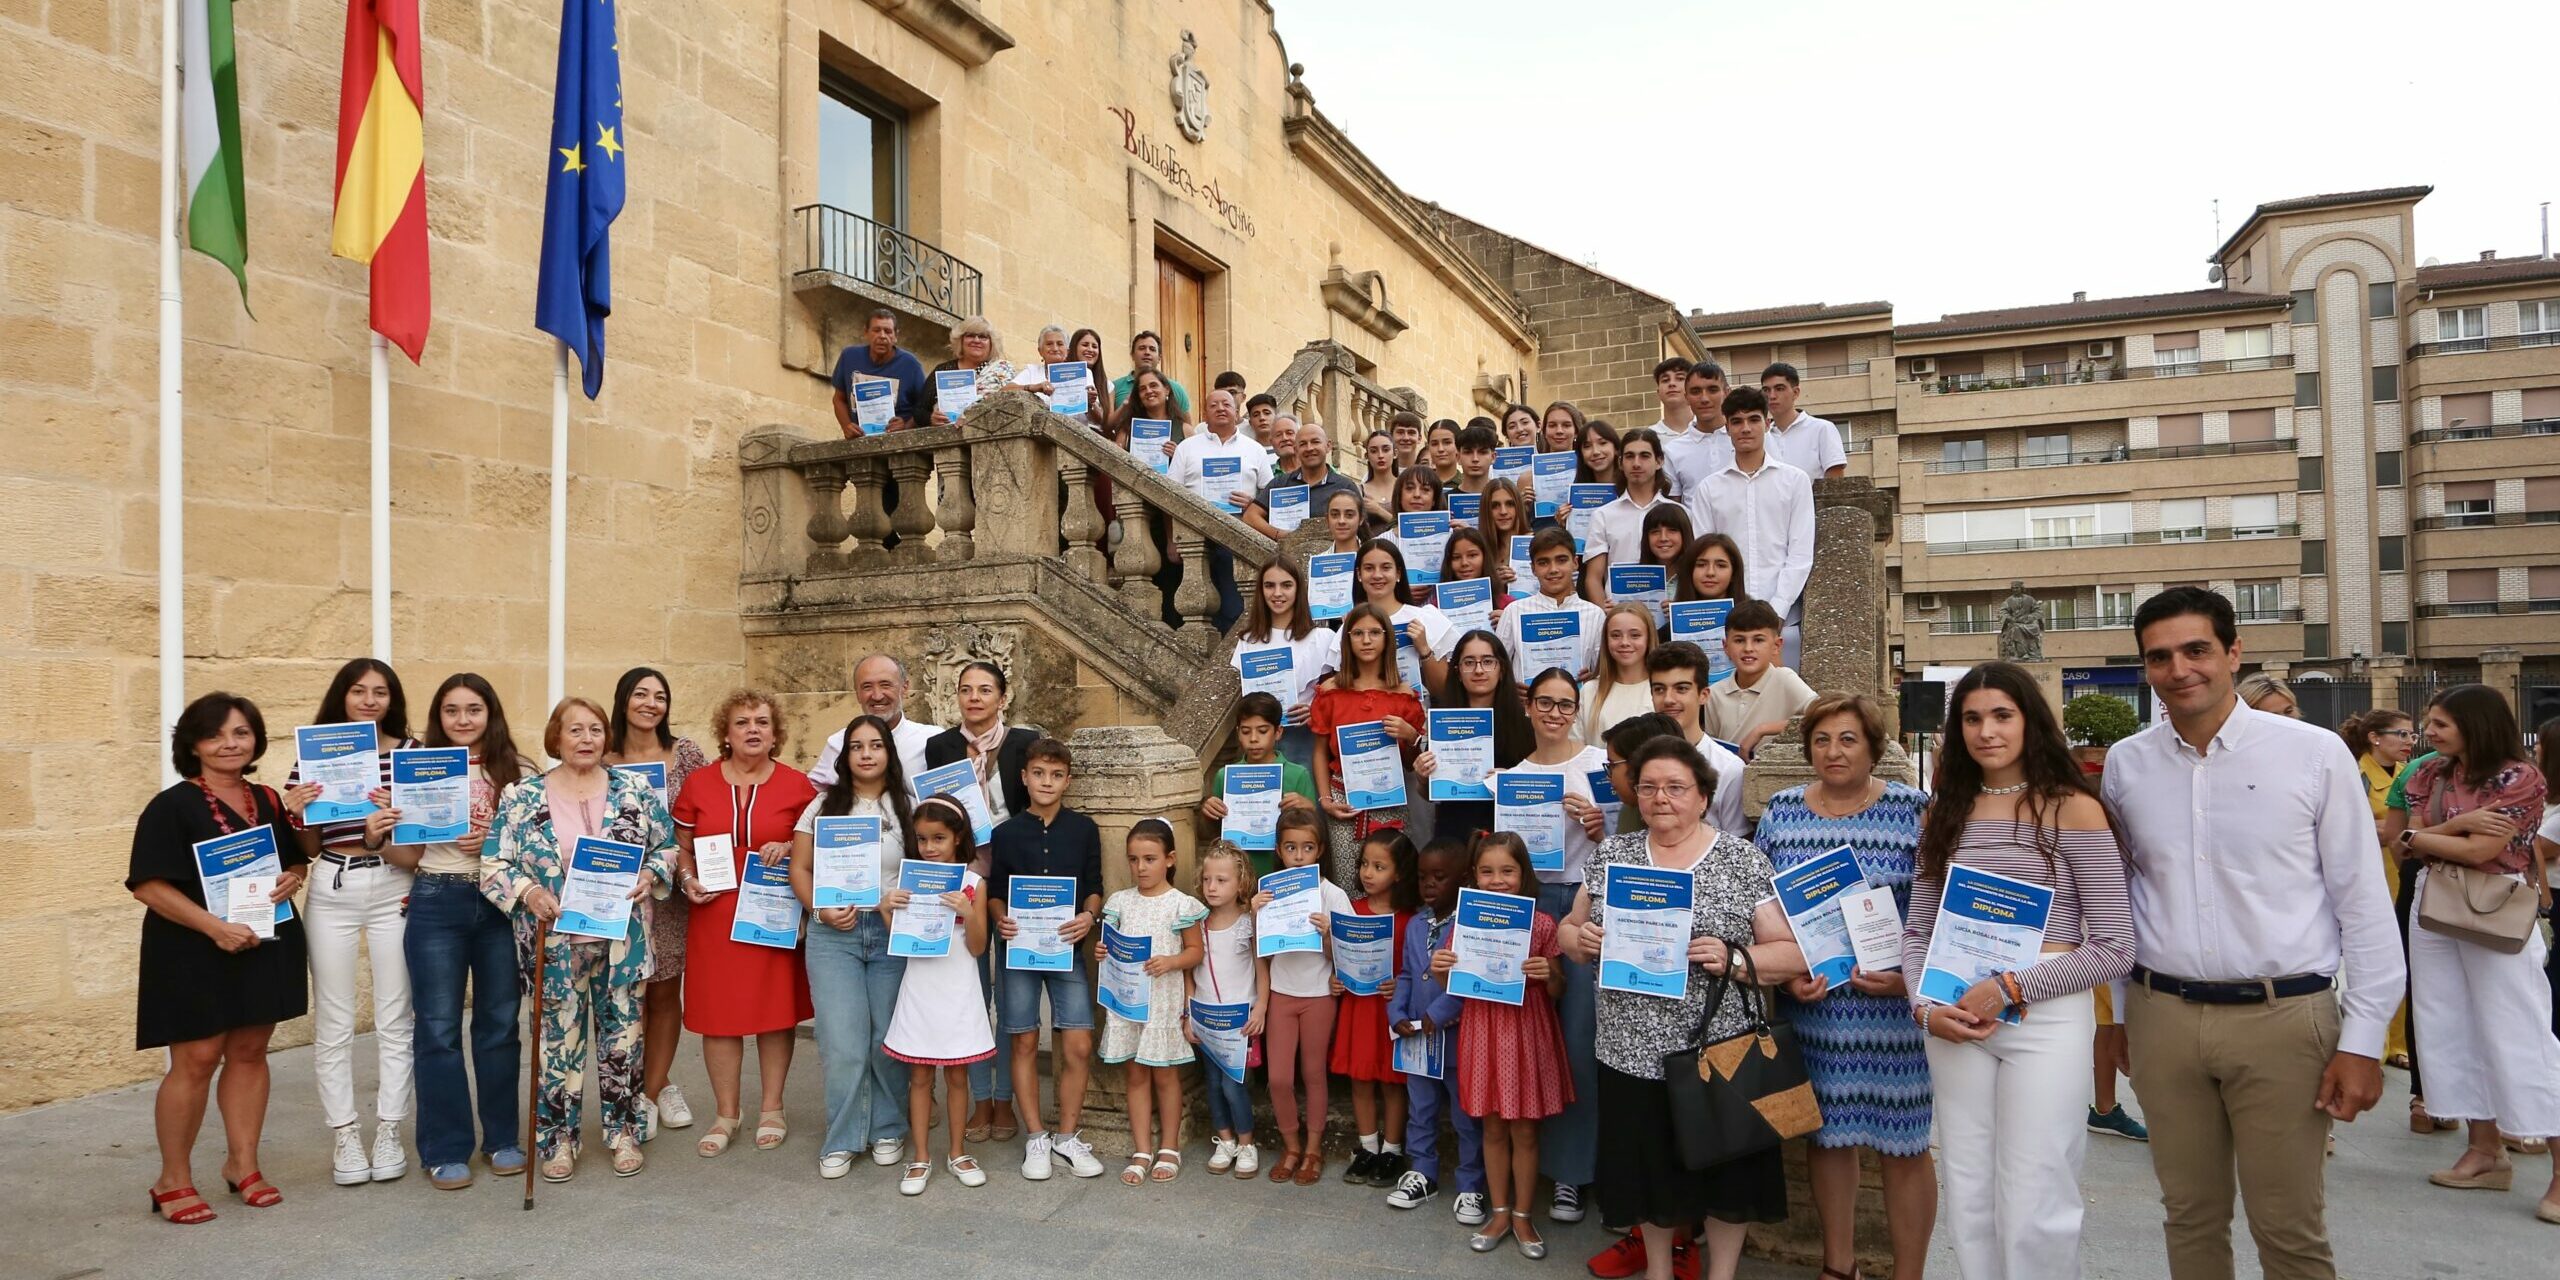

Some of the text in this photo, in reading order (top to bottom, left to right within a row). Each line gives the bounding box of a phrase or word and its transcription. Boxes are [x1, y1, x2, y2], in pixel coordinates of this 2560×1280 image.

[1108, 107, 1255, 238] BIBLIOTECA ARCHIVO
[2062, 672, 2090, 680] CASO
[321, 744, 354, 752] DIPLOMA
[934, 782, 960, 793] DIPLOMA
[222, 851, 256, 865] DIPLOMA
[591, 860, 620, 868] DIPLOMA
[1275, 884, 1301, 894] DIPLOMA
[1804, 880, 1839, 900] DIPLOMA
[1966, 884, 1997, 896] AYUNTAMIENTO
[2004, 894, 2020, 902] ALCALÁ
[1974, 881, 1998, 891] CONCEJALÍA
[2004, 890, 2030, 900] EDUCACIÓN
[1630, 894, 1666, 904] DIPLOMA
[1972, 902, 2015, 918] DIPLOMA
[1996, 902, 2016, 910] PRESENTE
[1478, 914, 1510, 924] DIPLOMA
[1954, 924, 2021, 947] LUCÍA ROSALES MARTÍN
